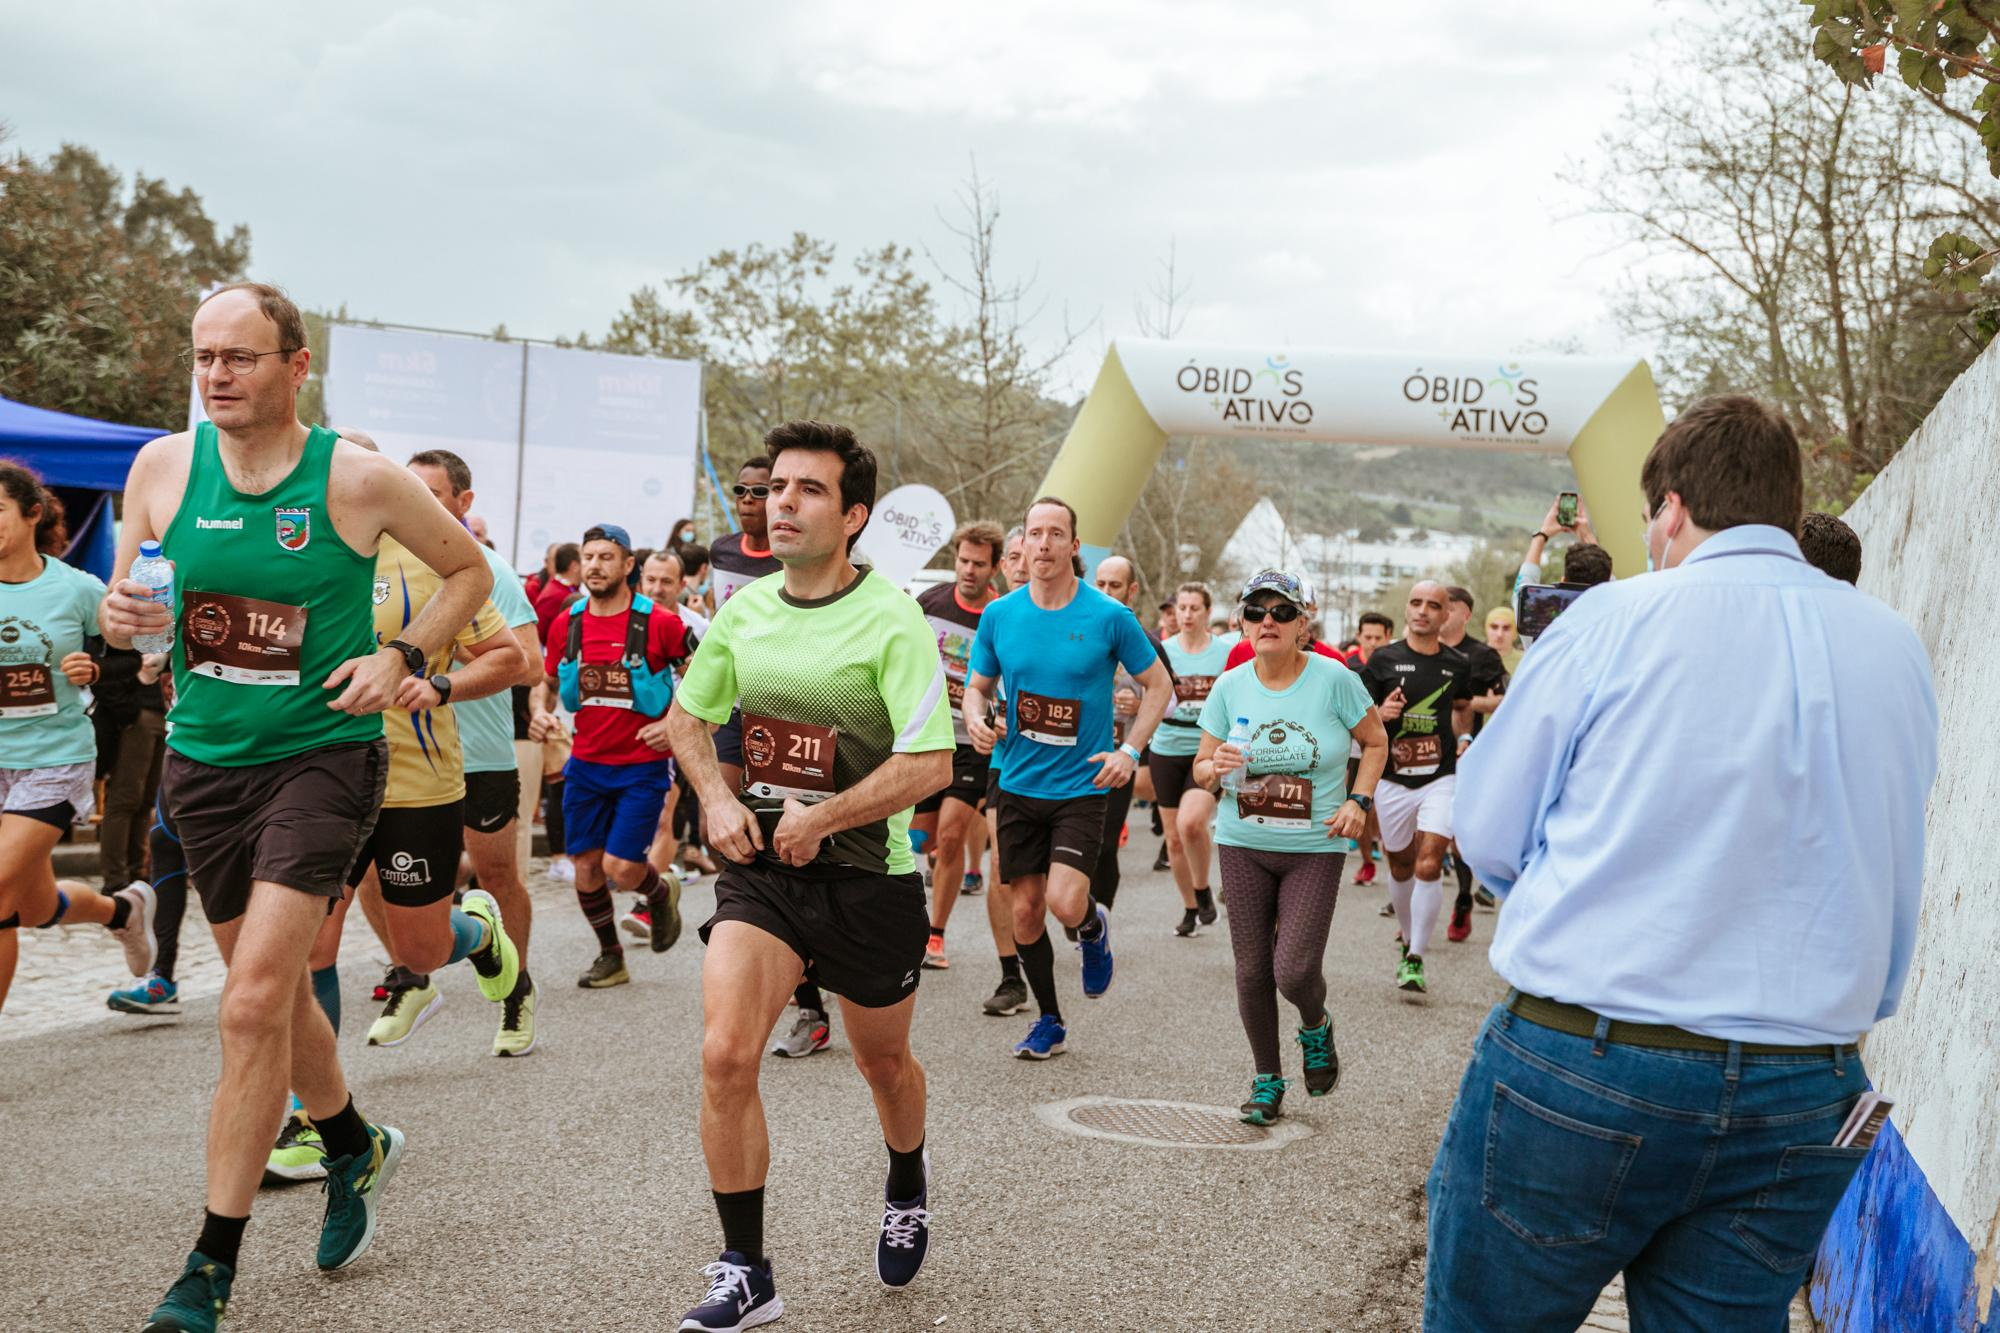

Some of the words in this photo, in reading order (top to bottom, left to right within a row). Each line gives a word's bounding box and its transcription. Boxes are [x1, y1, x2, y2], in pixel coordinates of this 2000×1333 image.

[196, 516, 244, 530] hummel
[247, 612, 287, 641] 114
[237, 641, 263, 654] 10km
[6, 669, 46, 688] 254
[606, 671, 628, 685] 156
[1047, 703, 1073, 720] 182
[787, 733, 821, 762] 211
[1416, 741, 1437, 754] 214
[782, 762, 803, 774] 10km
[1279, 783, 1303, 800] 171
[380, 868, 423, 882] CENTRAL
